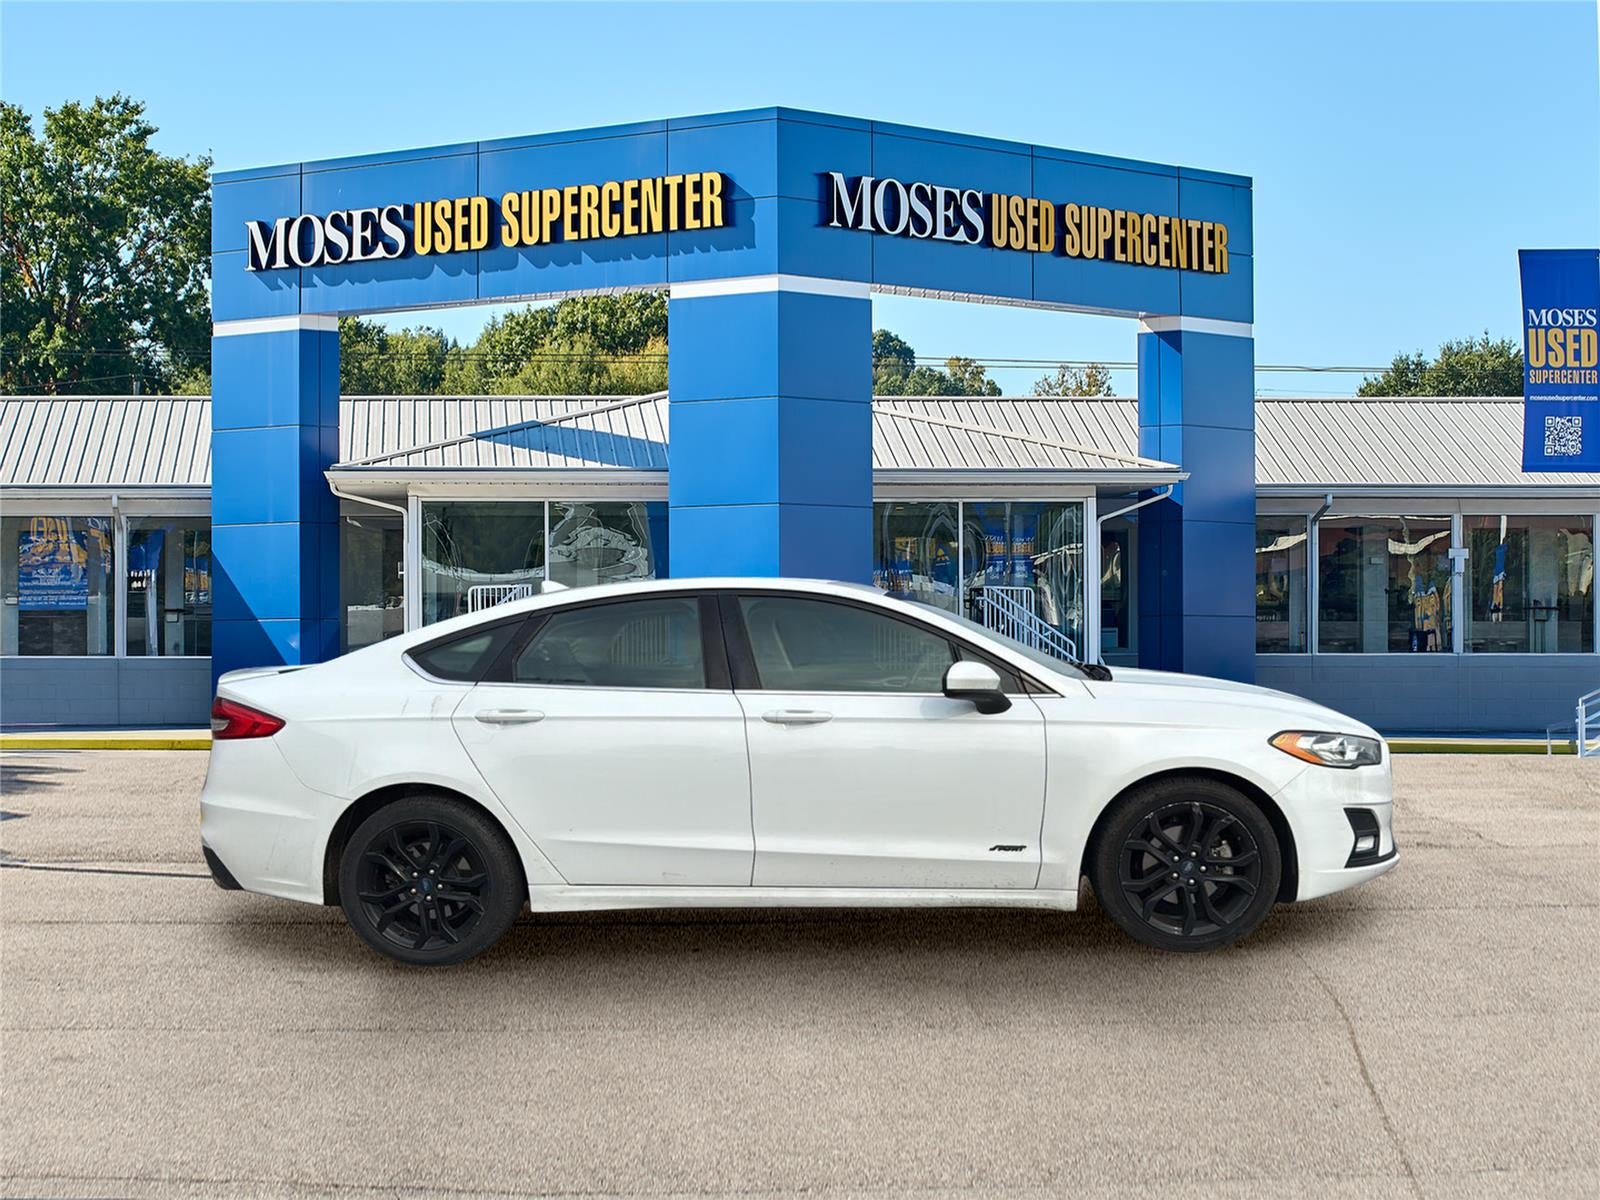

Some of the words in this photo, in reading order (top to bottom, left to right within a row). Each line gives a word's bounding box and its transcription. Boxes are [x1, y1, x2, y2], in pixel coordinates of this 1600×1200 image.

[244, 205, 406, 272] MOSES
[414, 196, 488, 256] USED
[501, 171, 724, 247] SUPERCENTER
[829, 171, 985, 245] MOSES
[991, 193, 1056, 253] USED
[1065, 203, 1230, 274] SUPERCENTER
[1528, 308, 1597, 328] MOSES
[1528, 328, 1598, 368] USED
[1529, 370, 1598, 384] SUPERCENTER
